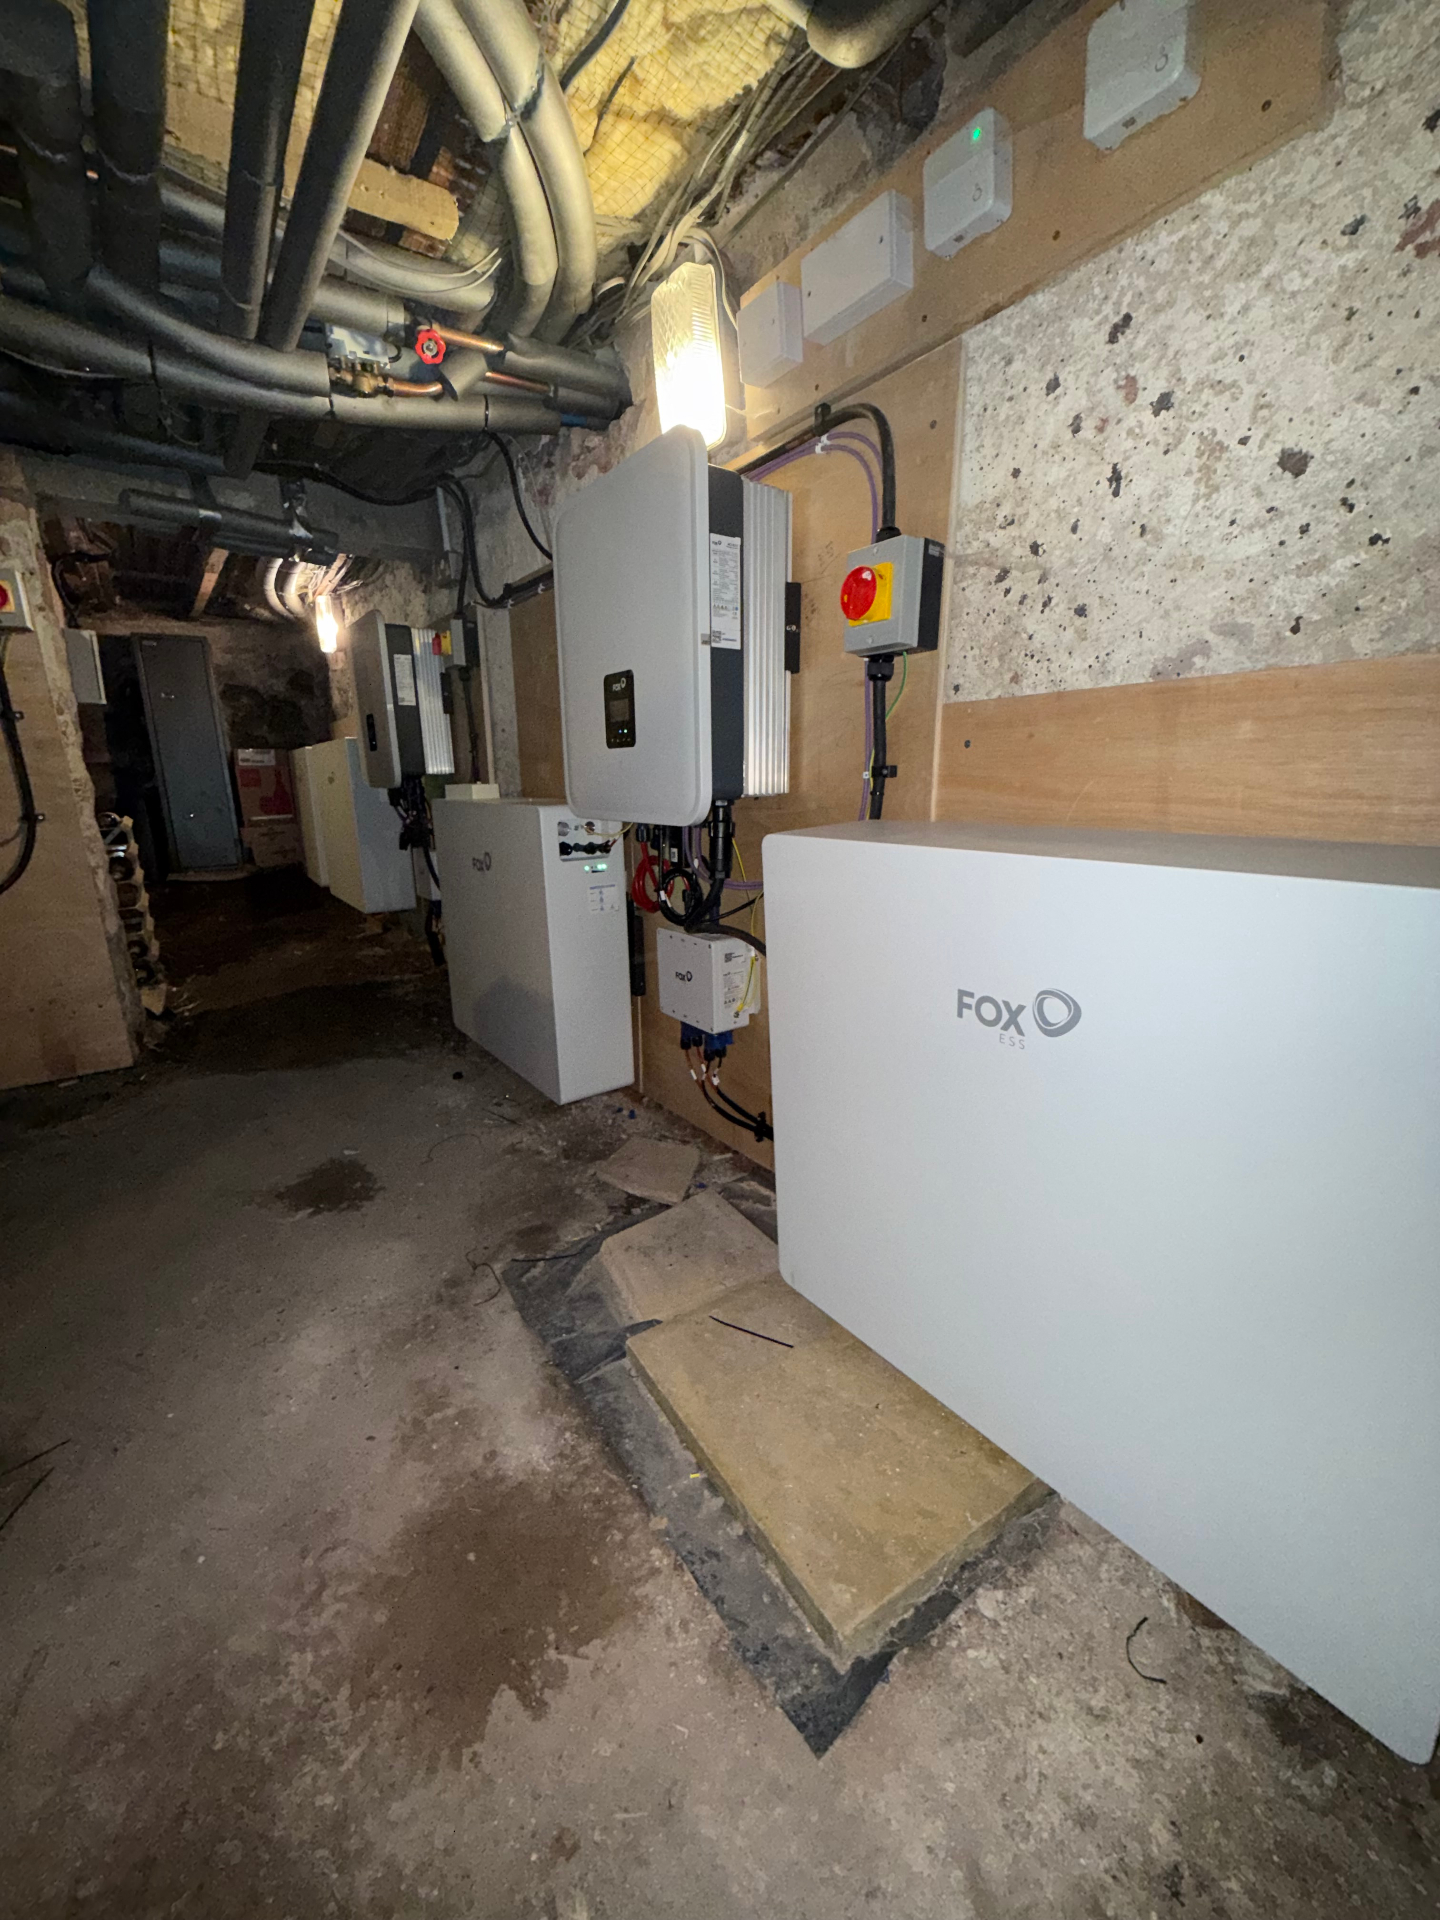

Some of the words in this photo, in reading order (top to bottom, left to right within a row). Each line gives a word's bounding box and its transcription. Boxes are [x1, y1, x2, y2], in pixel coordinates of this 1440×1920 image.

[472, 857, 484, 871] FOX
[675, 971, 686, 982] FOX
[956, 988, 1027, 1037] FOX
[999, 1033, 1026, 1050] ESS
